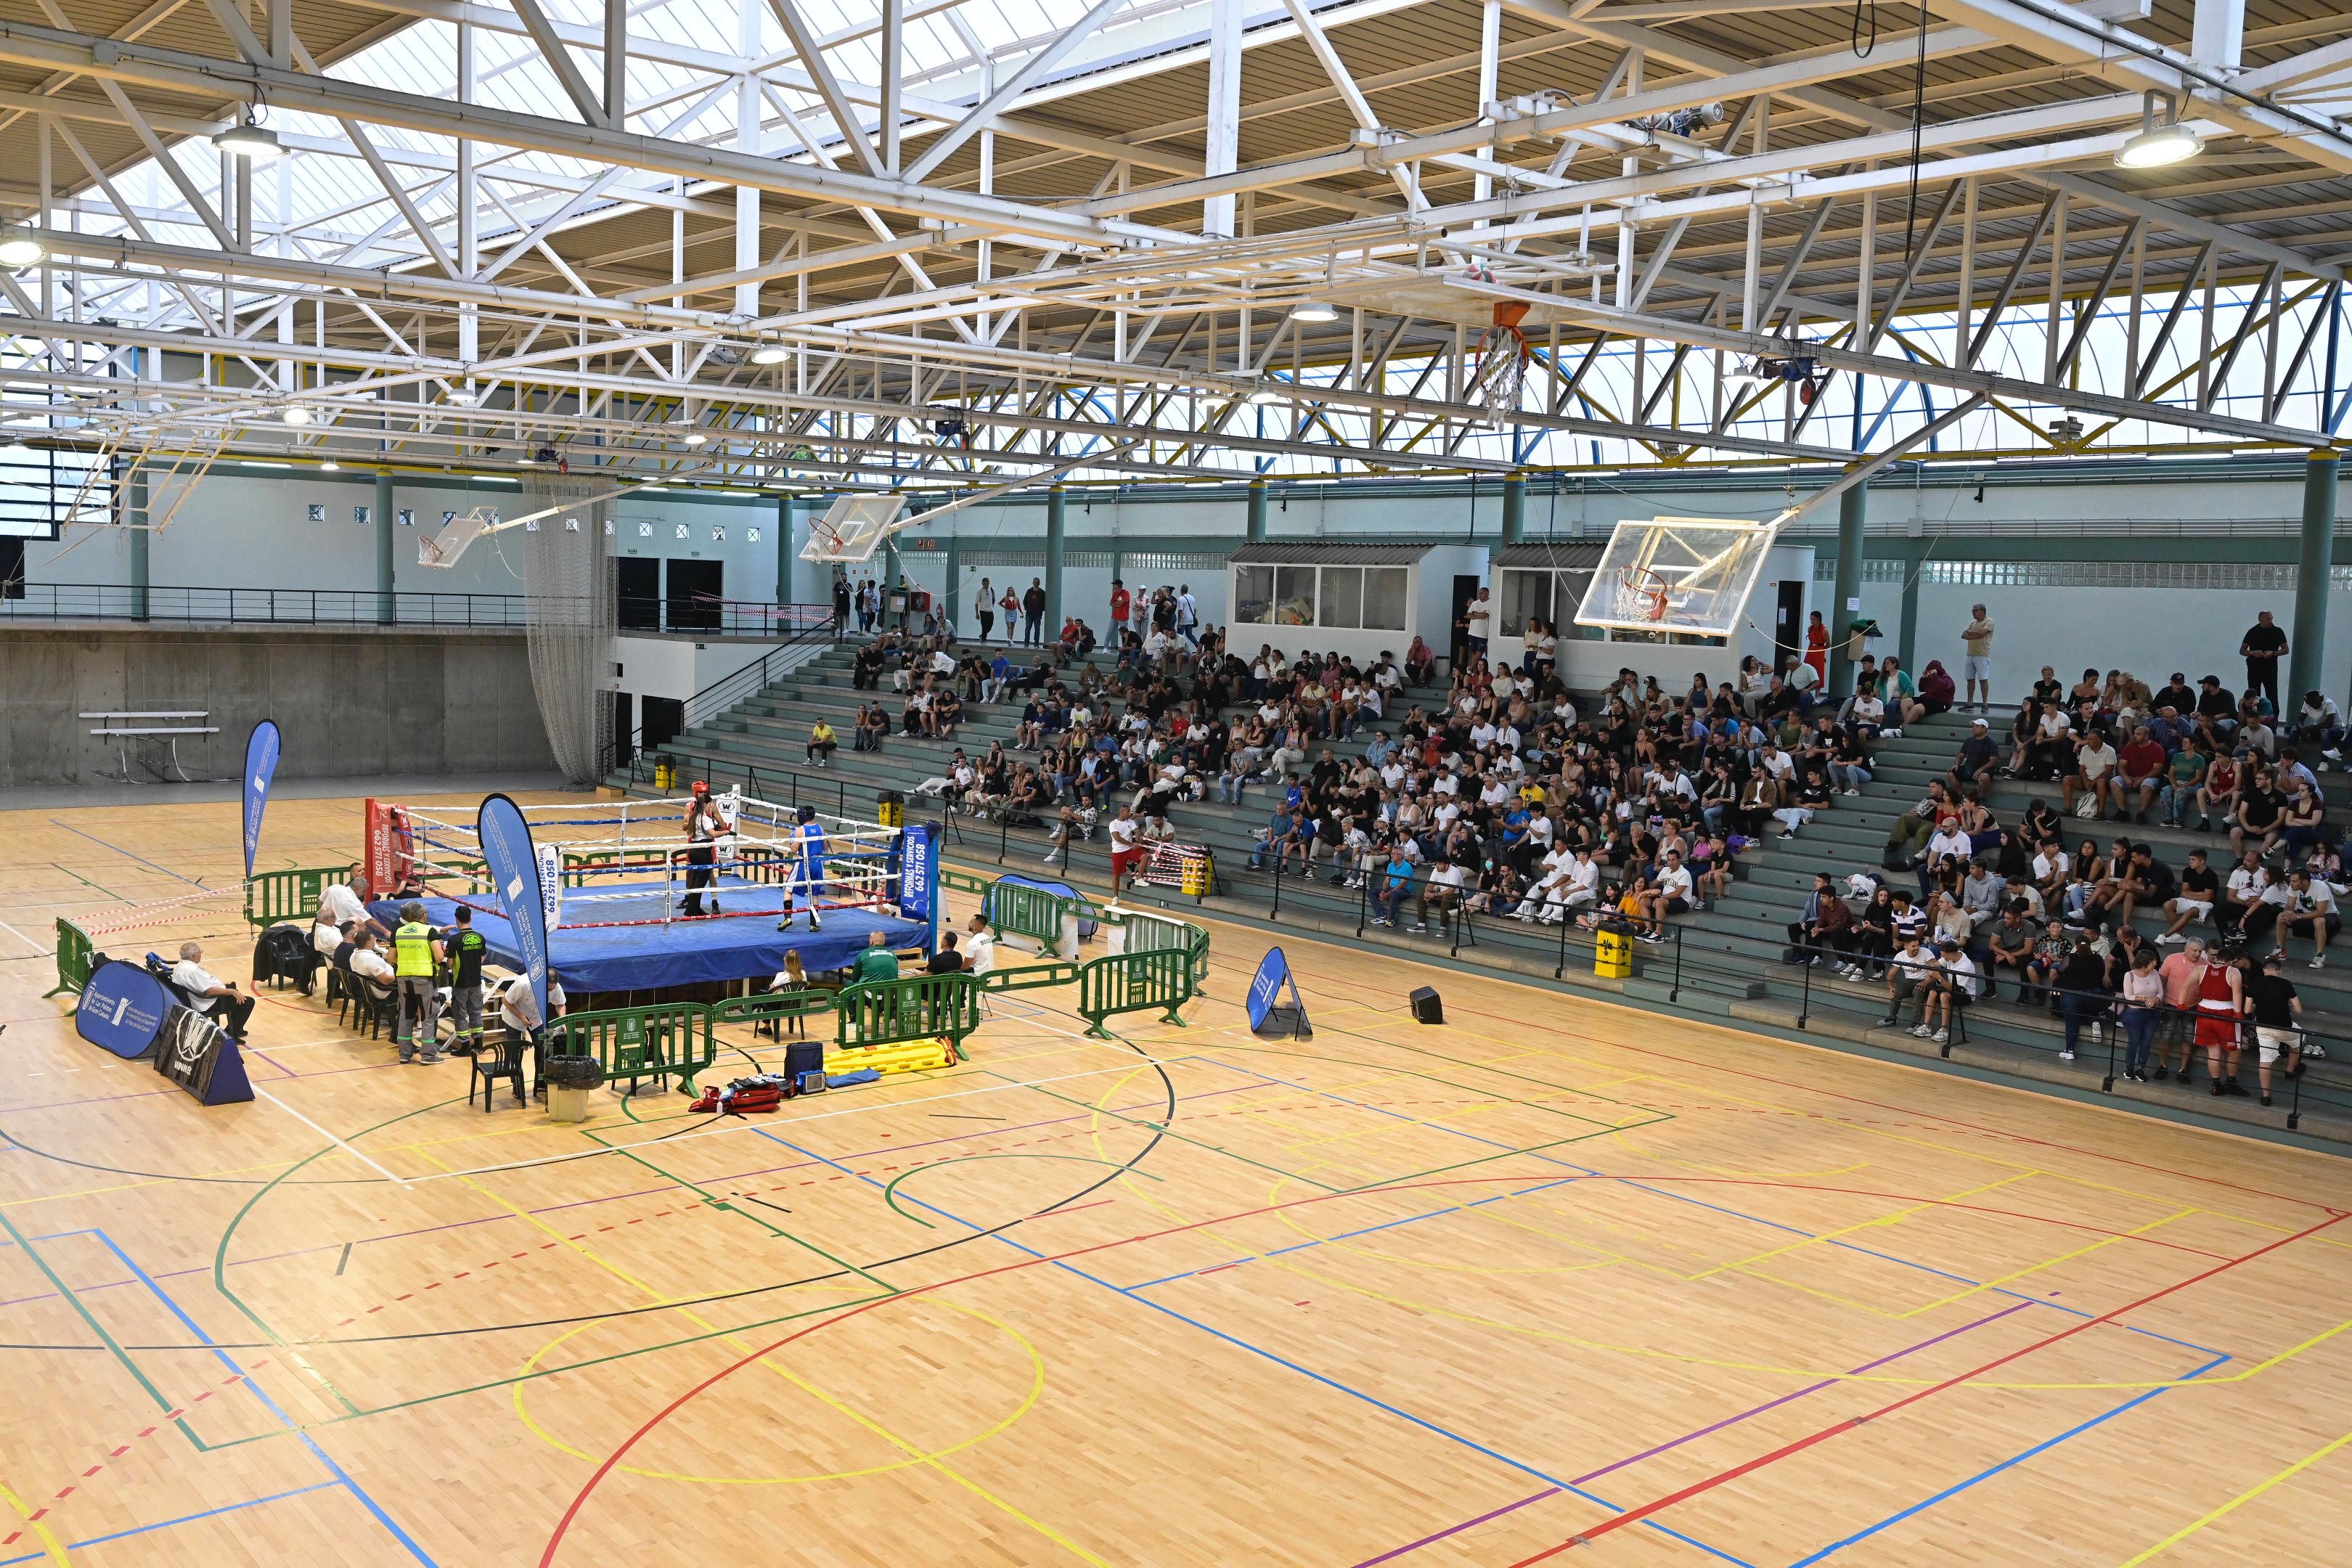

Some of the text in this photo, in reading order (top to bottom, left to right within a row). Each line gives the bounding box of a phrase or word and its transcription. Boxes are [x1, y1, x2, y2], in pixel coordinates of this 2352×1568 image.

[906, 836, 915, 863] SERVICIOS
[915, 844, 926, 860] 058
[383, 857, 392, 884] SERVICIOS
[546, 859, 555, 878] 058
[915, 862, 925, 875] 571
[904, 869, 915, 897] REFORMAS
[915, 877, 924, 892] 662
[94, 992, 115, 1005] Ayuntamiento
